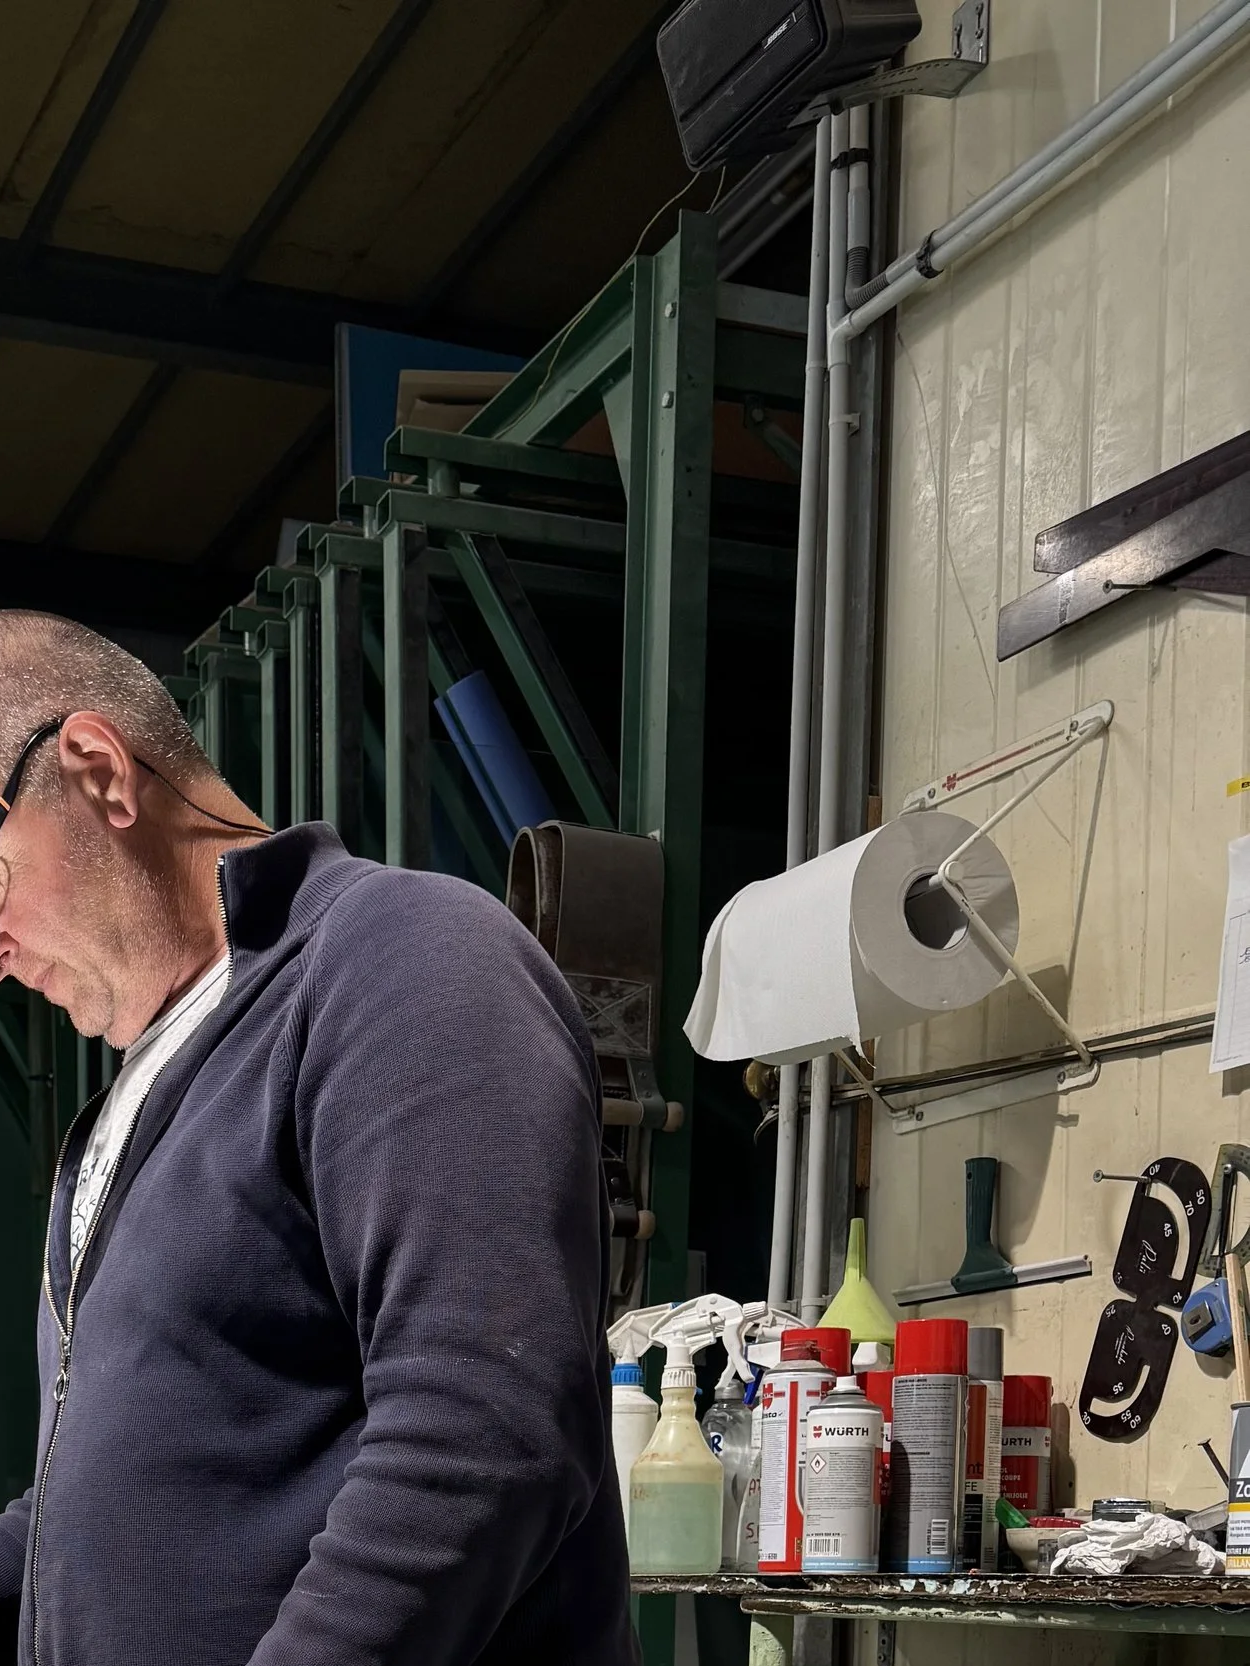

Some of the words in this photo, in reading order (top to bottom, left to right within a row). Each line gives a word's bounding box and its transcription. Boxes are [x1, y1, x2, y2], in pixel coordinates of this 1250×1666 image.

[1196, 1189, 1205, 1205] 50
[1184, 1200, 1195, 1216] 70
[1163, 1222, 1173, 1238] 45
[1172, 1291, 1183, 1305] 10
[1105, 1304, 1116, 1318] 25
[1161, 1323, 1172, 1336] 40
[1112, 1381, 1125, 1395] 35
[1120, 1409, 1132, 1423] 55
[1129, 1414, 1142, 1429] 60
[825, 1426, 869, 1437] WÜRTH
